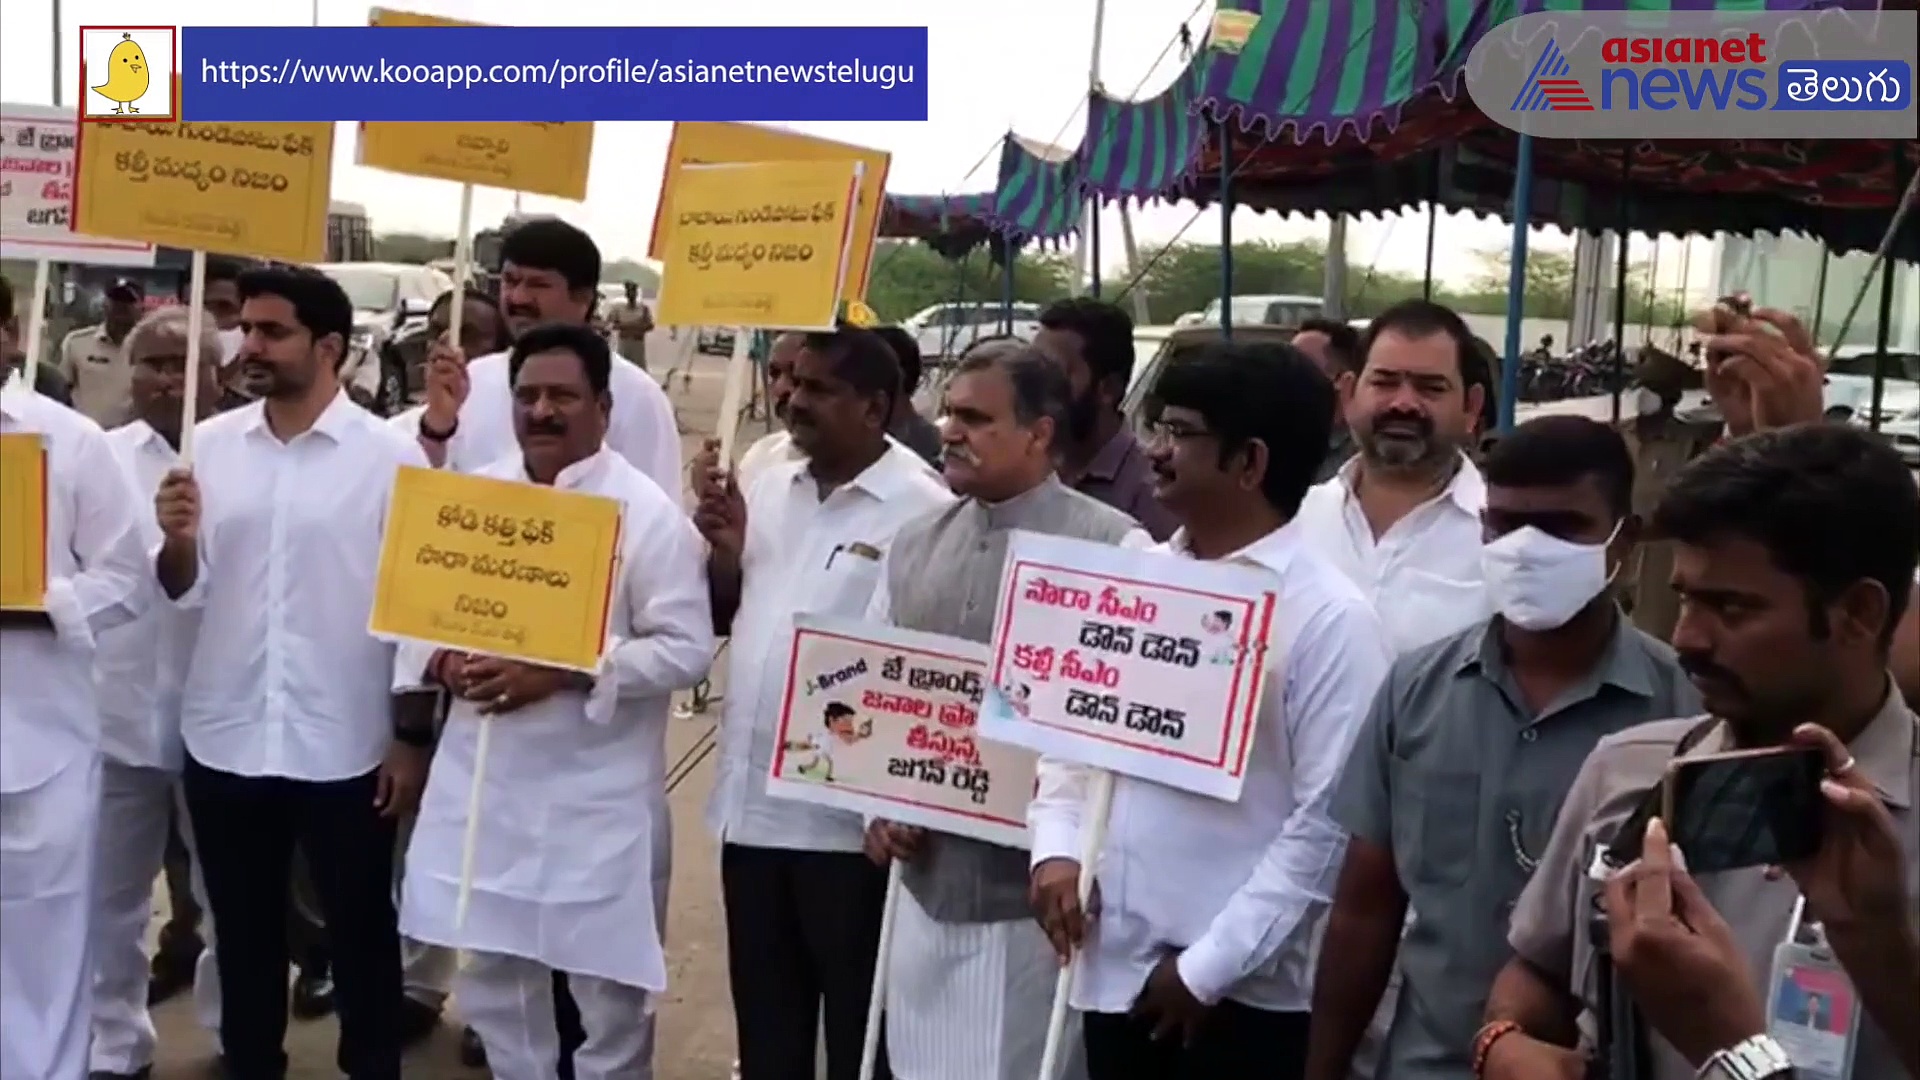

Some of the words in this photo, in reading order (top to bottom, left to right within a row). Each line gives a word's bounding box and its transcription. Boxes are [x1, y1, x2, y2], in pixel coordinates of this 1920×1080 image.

[232, 166, 289, 192] నిజం
[436, 504, 478, 532] కోడి
[416, 543, 469, 570] సారా
[470, 553, 571, 589] మరణాలు
[453, 593, 509, 620] నిజం
[1025, 577, 1092, 612] సారా
[1096, 583, 1158, 624] సీఎం
[1079, 620, 1136, 655] డౌన్
[1140, 631, 1203, 668] డౌన్
[1059, 648, 1121, 689] సీఎం
[861, 689, 932, 719] జనాల
[1064, 688, 1122, 725] డౌన్
[1125, 701, 1187, 740] డౌన్
[887, 757, 946, 785] జగన్
[952, 765, 990, 805] రెడ్డి
